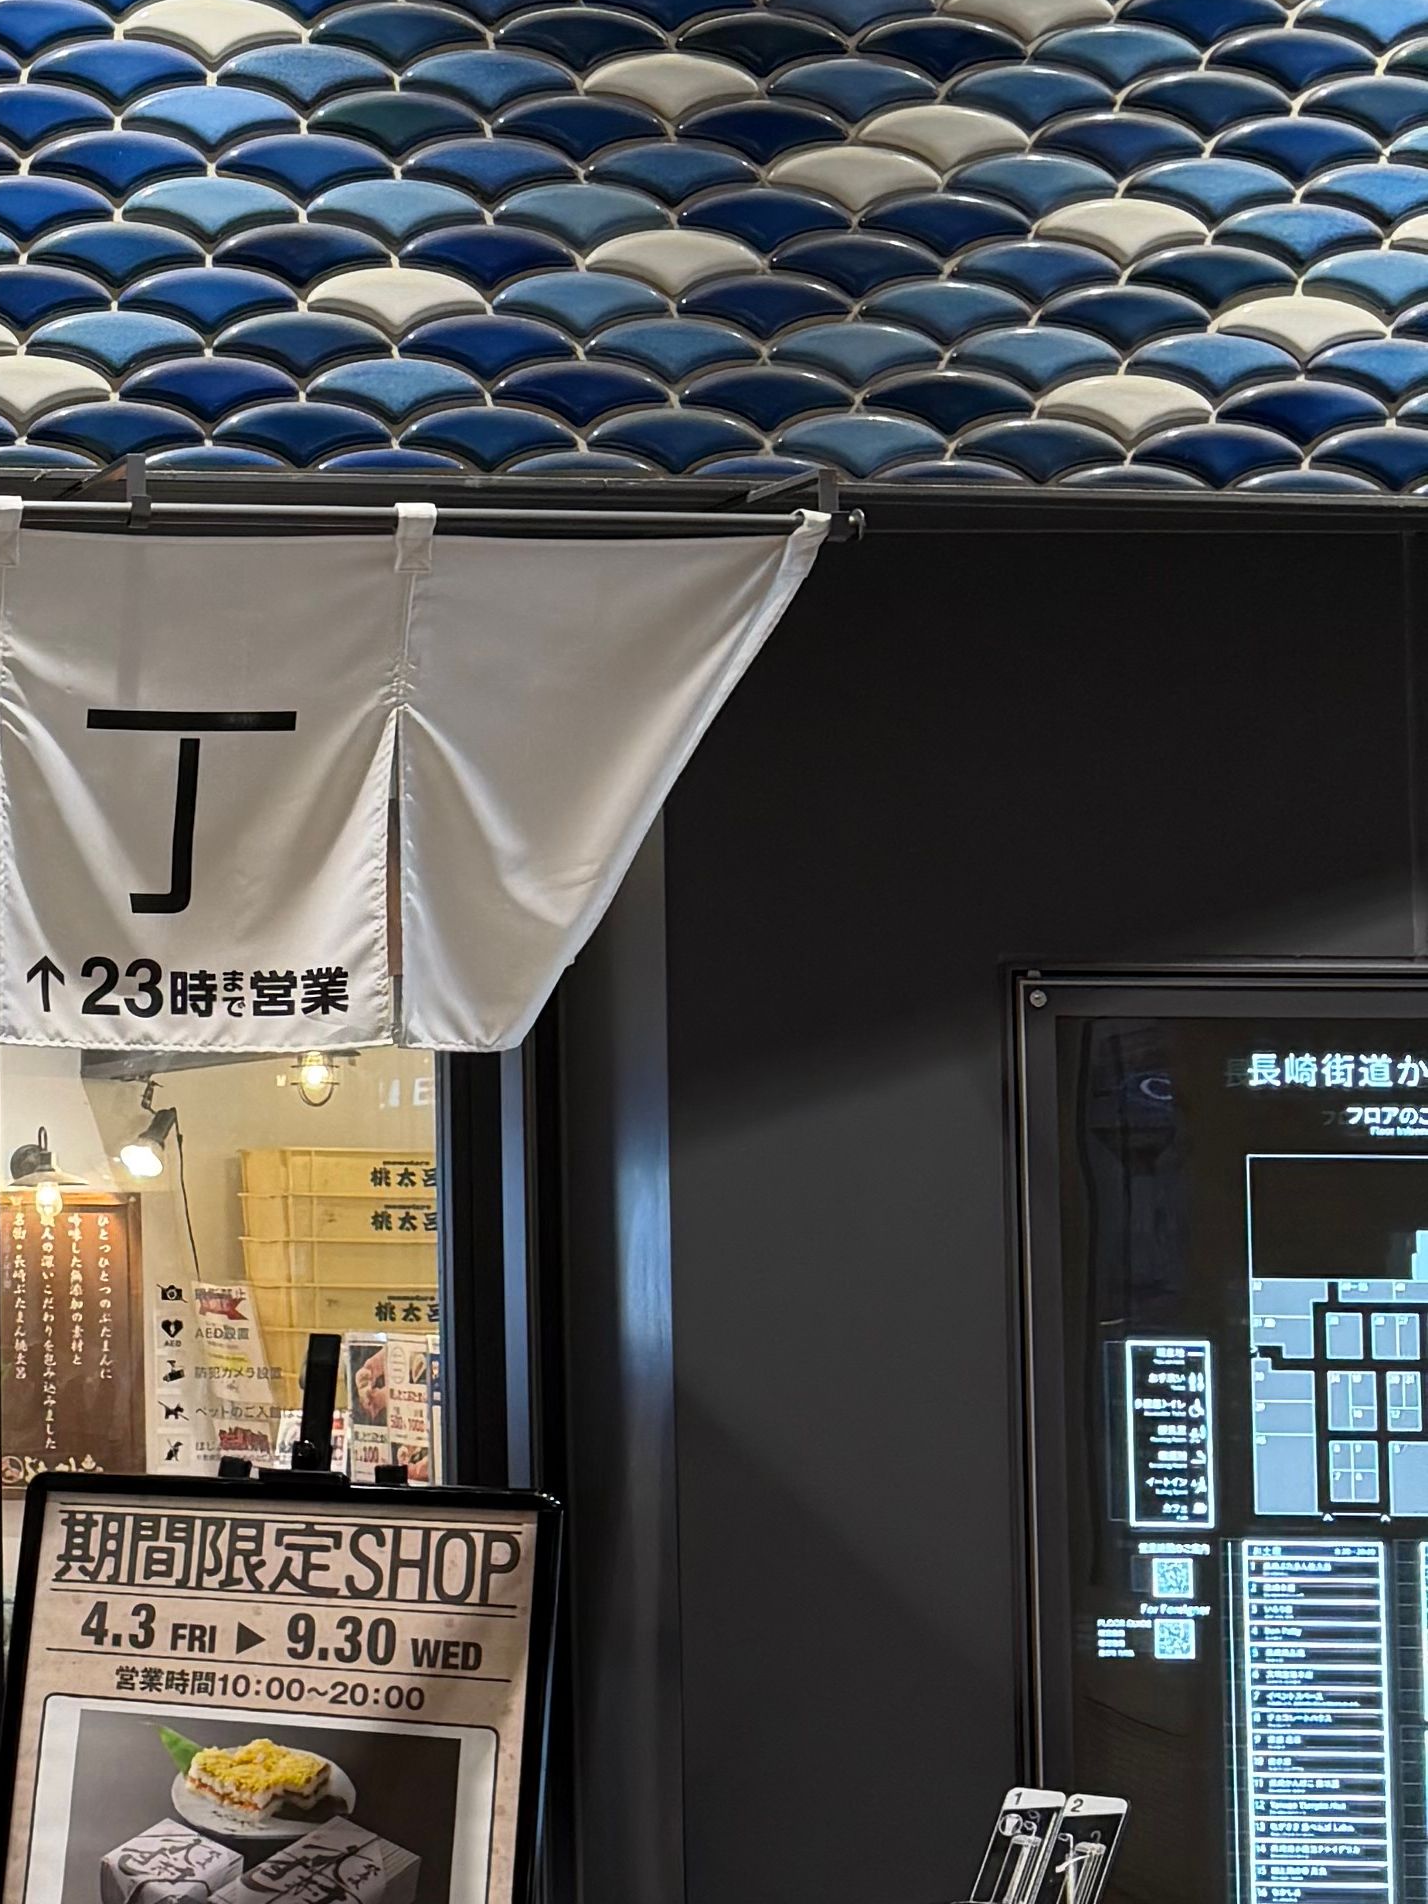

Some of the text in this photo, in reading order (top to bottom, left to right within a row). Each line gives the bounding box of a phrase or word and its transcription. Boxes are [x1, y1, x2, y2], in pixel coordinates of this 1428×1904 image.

[80, 956, 349, 1019] 23時まで営業
[97, 1214, 113, 1380] ひとつひとつのぶたまんに
[194, 1327, 249, 1340] AED設置
[194, 1366, 282, 1380] 防犯カメラ設置
[53, 1510, 522, 1607] 期間限定SHOP
[80, 1600, 483, 1672] 4.3 FRI 9.30 WED
[1013, 1791, 1084, 1814] 1 2
